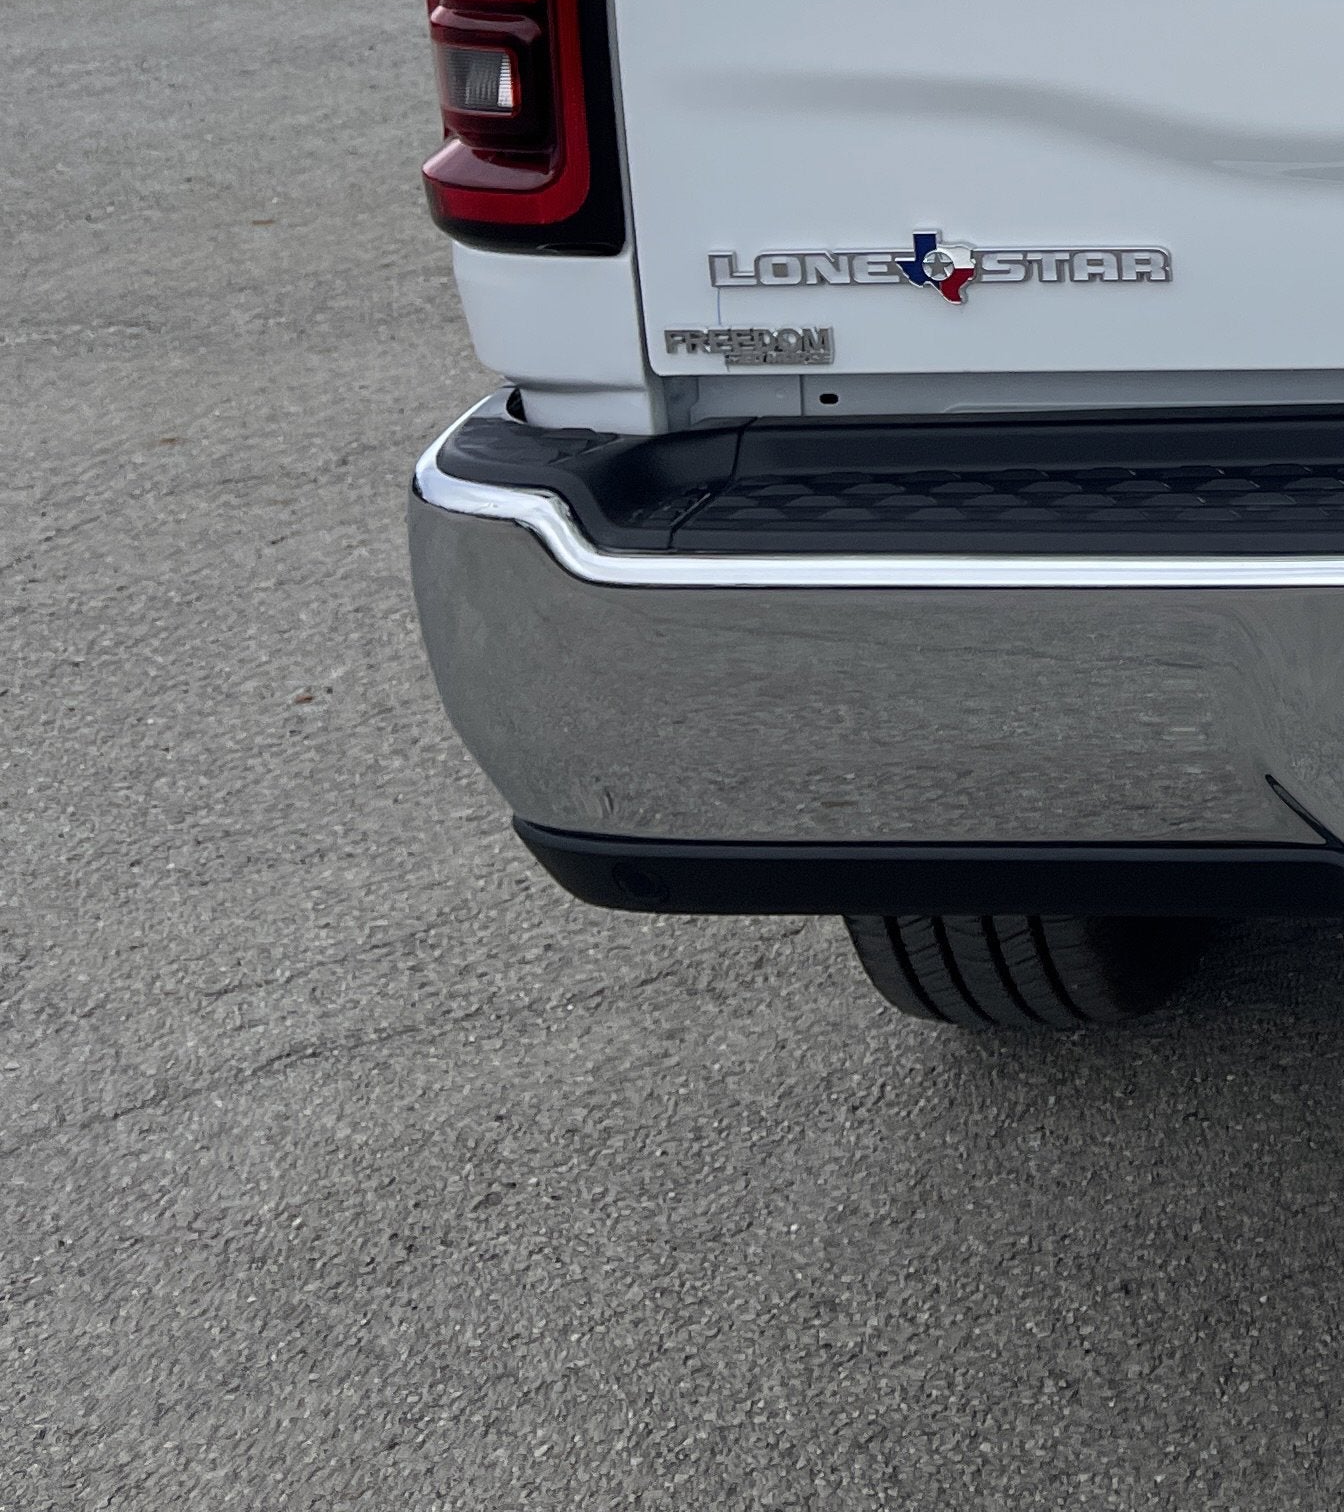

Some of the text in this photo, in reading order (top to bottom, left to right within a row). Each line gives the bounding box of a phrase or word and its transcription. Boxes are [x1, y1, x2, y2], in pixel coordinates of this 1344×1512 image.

[708, 246, 1174, 288] LONE STAR
[664, 327, 831, 354] FREEDOM
